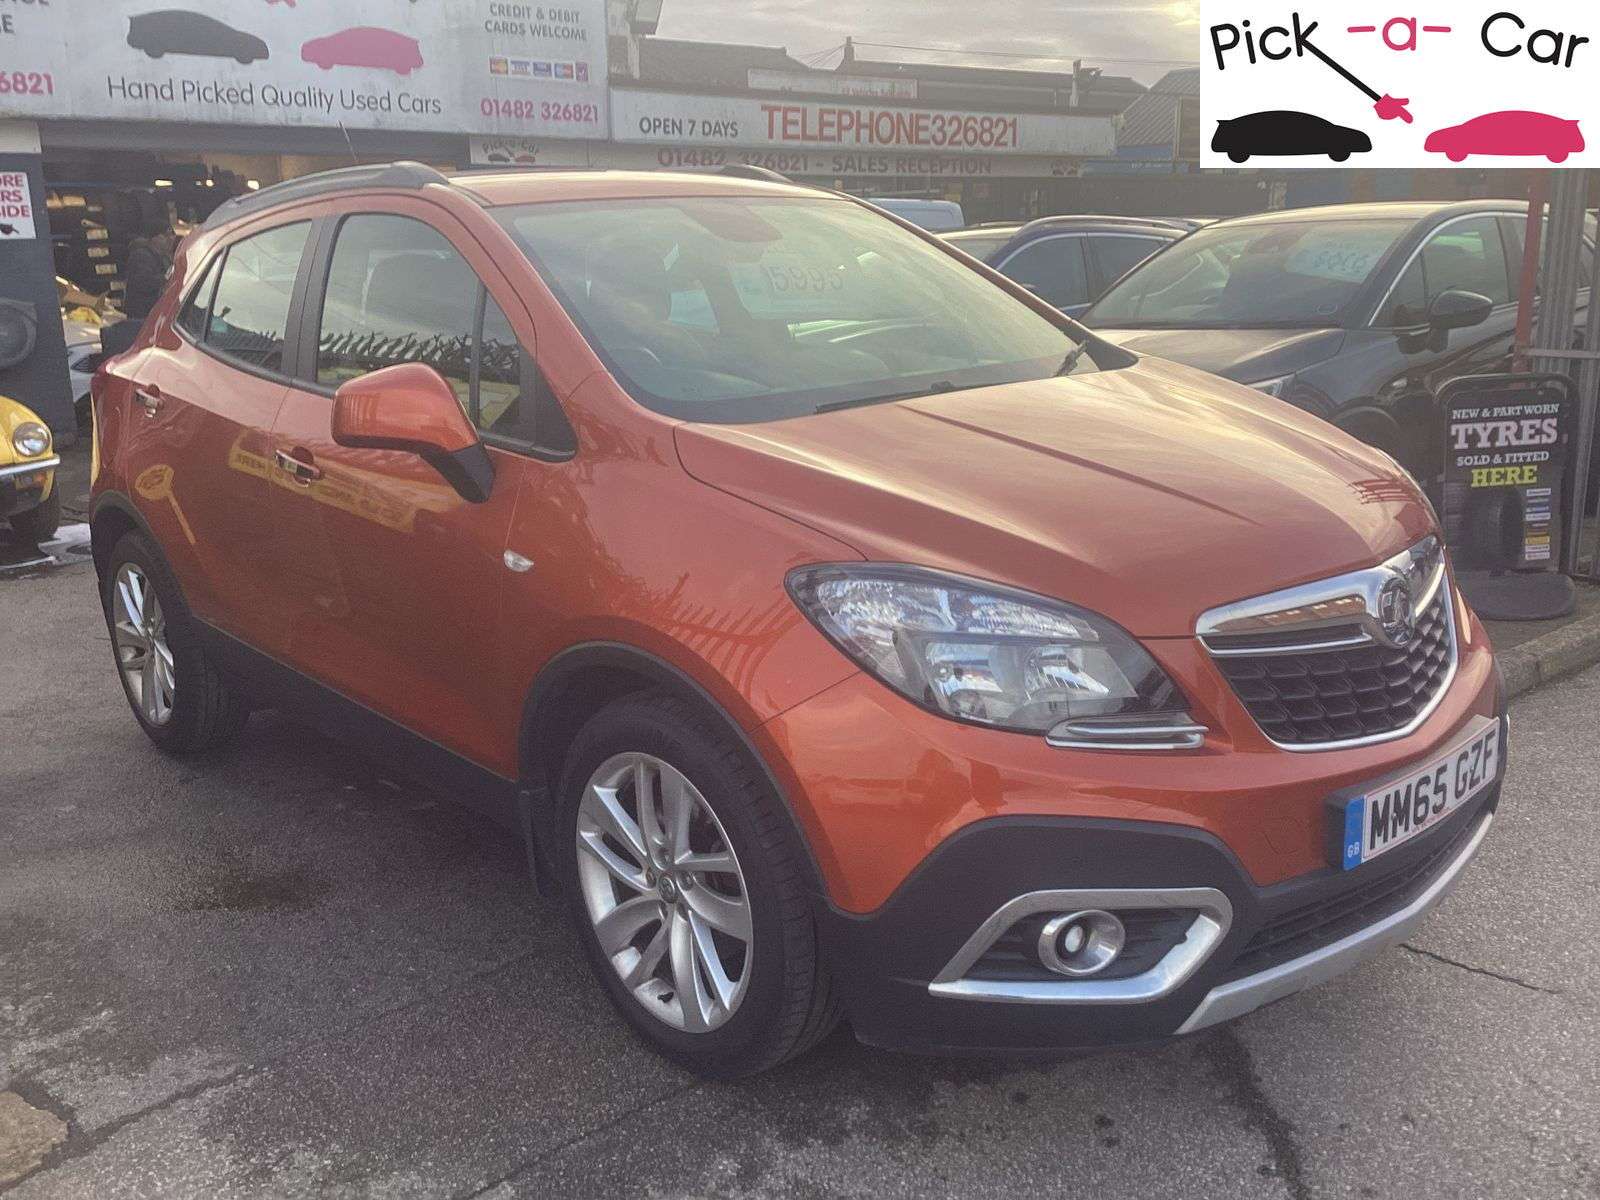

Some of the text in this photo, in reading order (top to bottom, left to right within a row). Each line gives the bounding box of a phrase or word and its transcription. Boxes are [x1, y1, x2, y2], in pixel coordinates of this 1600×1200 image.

[490, 3, 580, 24] CREDIT & DEBIT
[485, 20, 587, 41] CARDS WELCOME
[107, 75, 442, 115] Hand Picked Quality Used Cars
[481, 97, 599, 123] 01482 326821
[639, 116, 739, 139] OPEN 7 DAYS
[657, 148, 727, 167] 01482
[832, 156, 889, 174] SALES
[895, 157, 992, 175] RECEPTION
[1452, 408, 1479, 419] NEW
[1451, 417, 1558, 450] TYRES
[1456, 451, 1550, 467] SOLD & FITTED
[1471, 465, 1538, 488] HERE
[1370, 729, 1496, 850] MM65 GZF
[1347, 842, 1360, 858] GB
